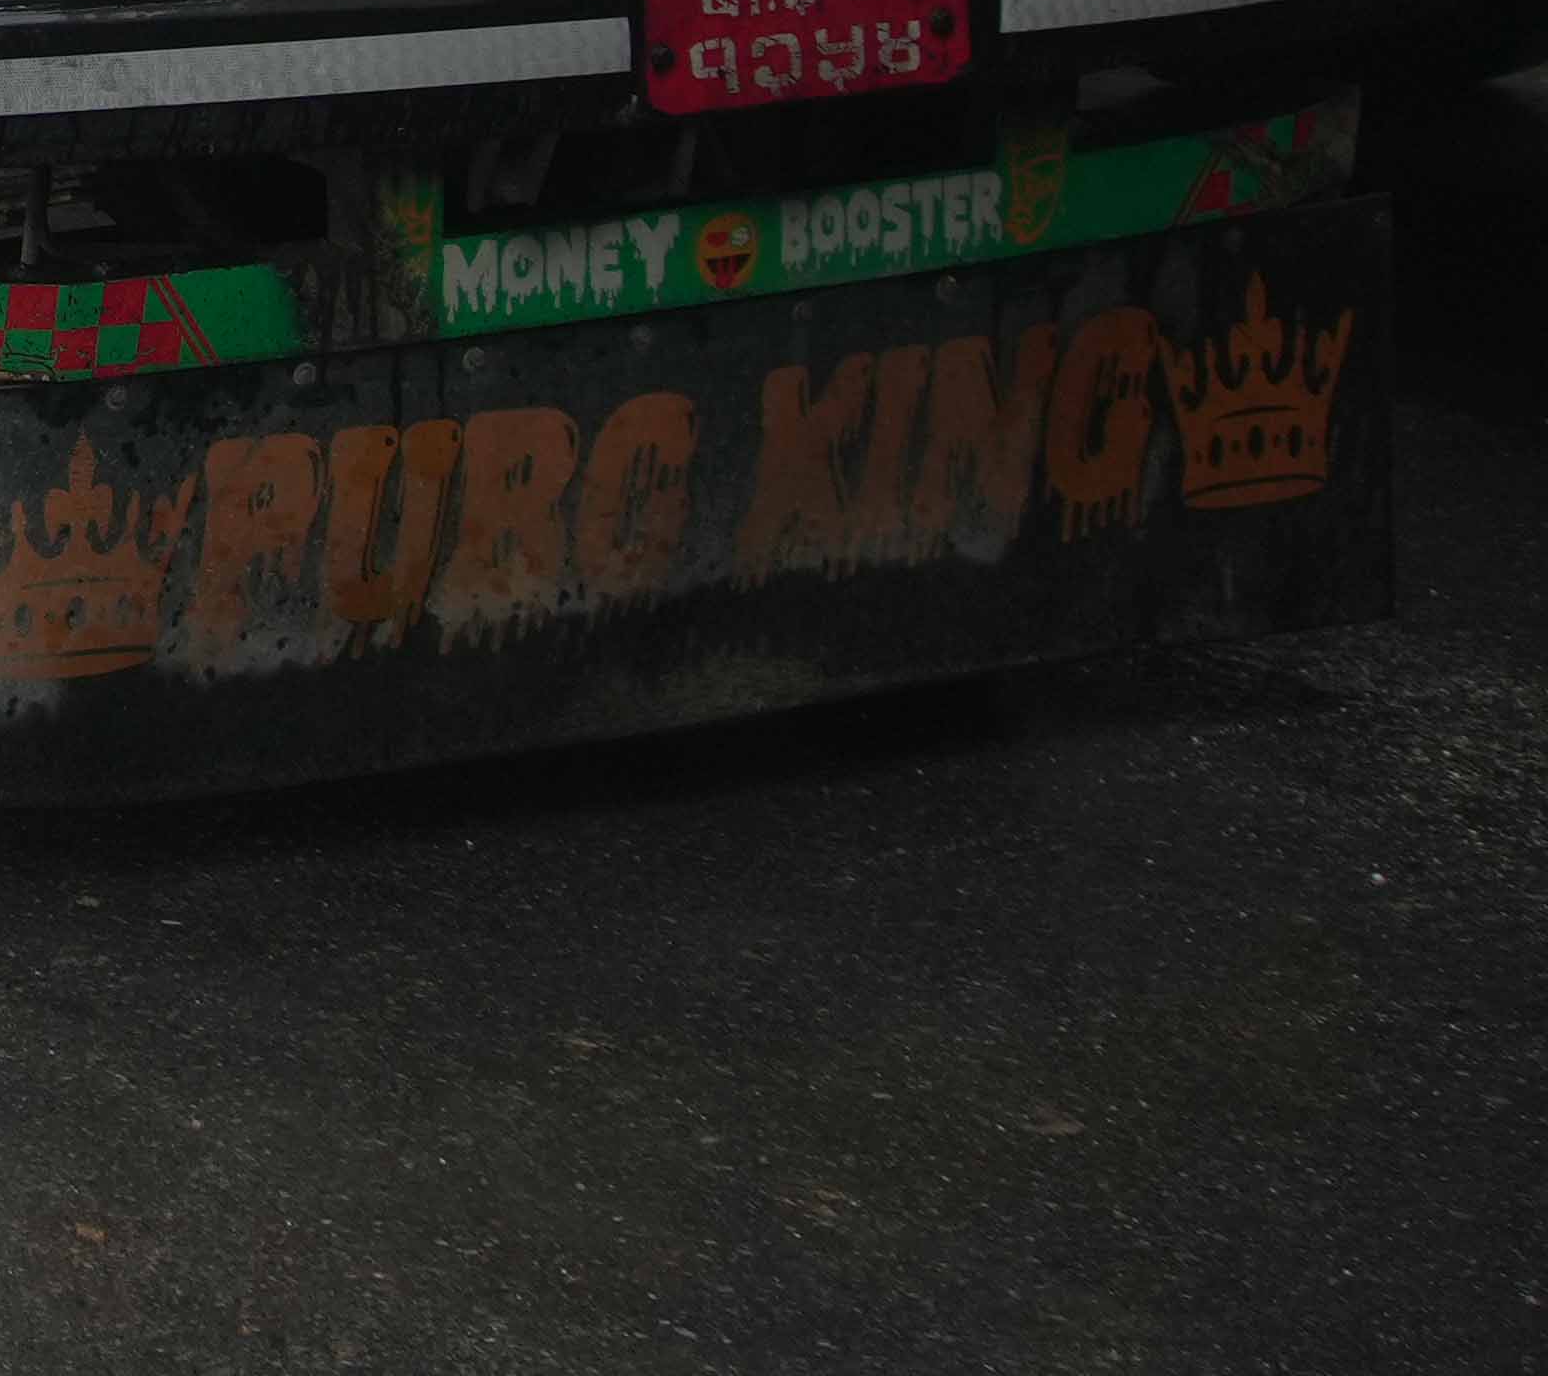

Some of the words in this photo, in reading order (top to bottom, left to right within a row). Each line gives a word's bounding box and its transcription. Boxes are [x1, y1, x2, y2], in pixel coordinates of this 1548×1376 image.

[442, 212, 681, 324] MONEY
[780, 171, 1005, 272] BOOSTER
[732, 305, 1160, 590] KING
